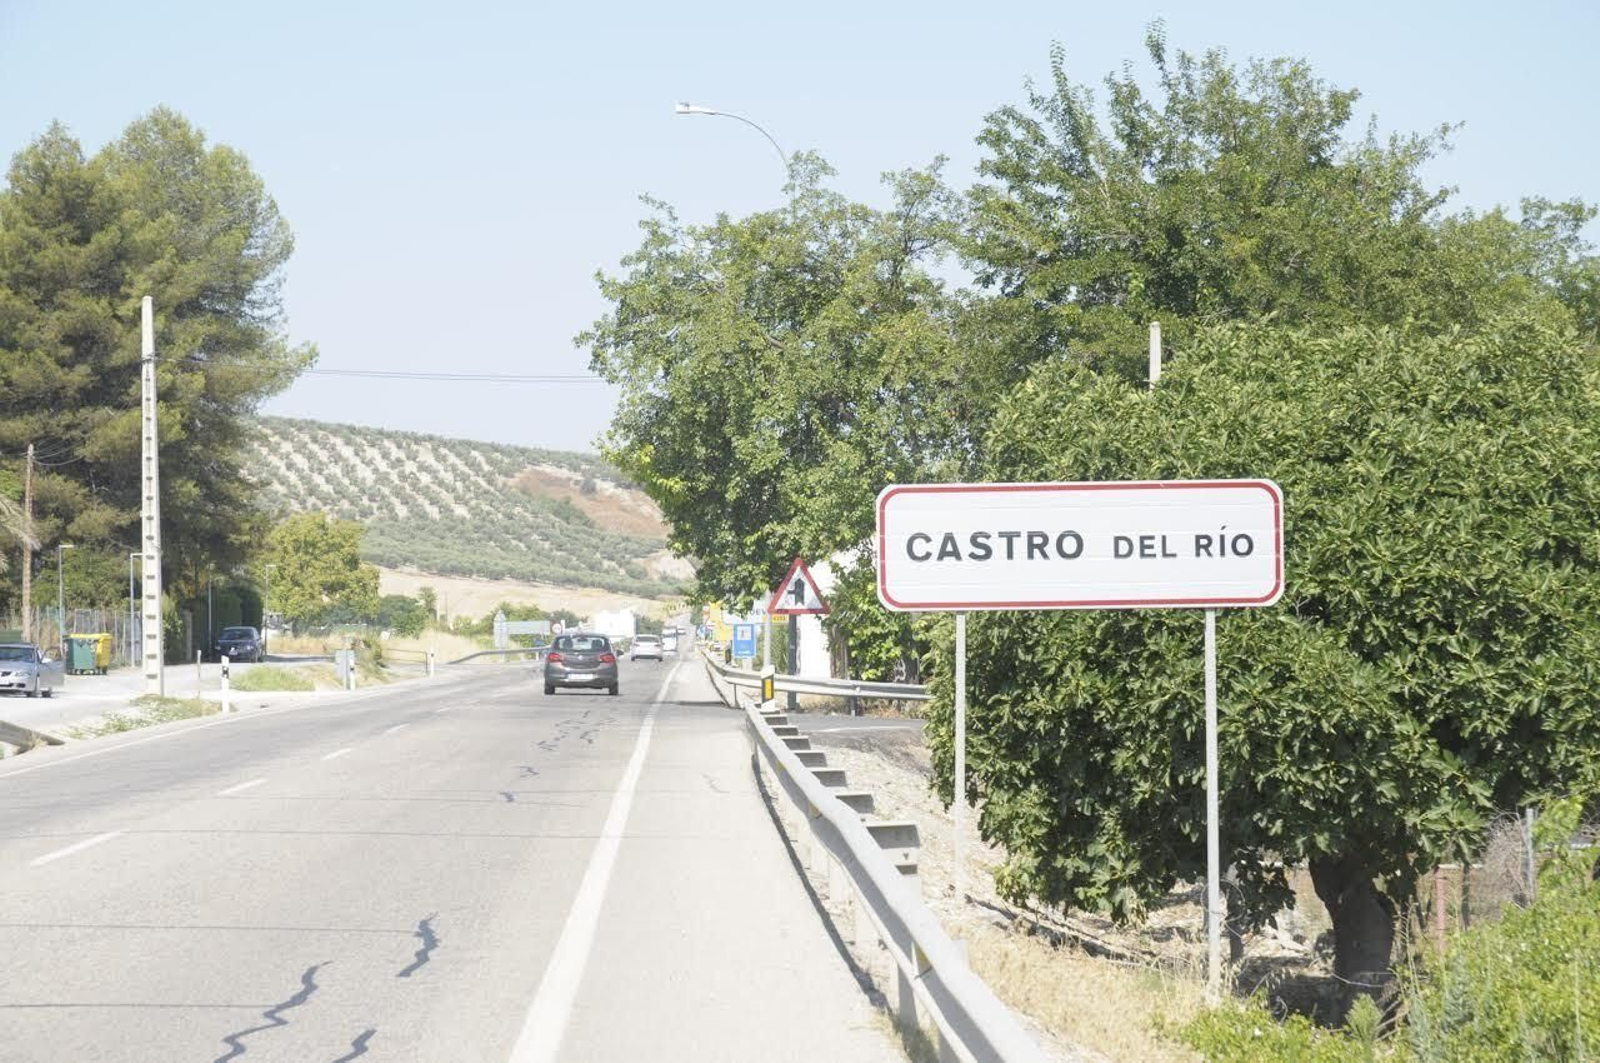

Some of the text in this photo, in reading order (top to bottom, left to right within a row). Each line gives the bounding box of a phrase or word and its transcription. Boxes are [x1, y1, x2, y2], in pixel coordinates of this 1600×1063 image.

[906, 525, 1254, 563] CASTRO DEL RÍO
